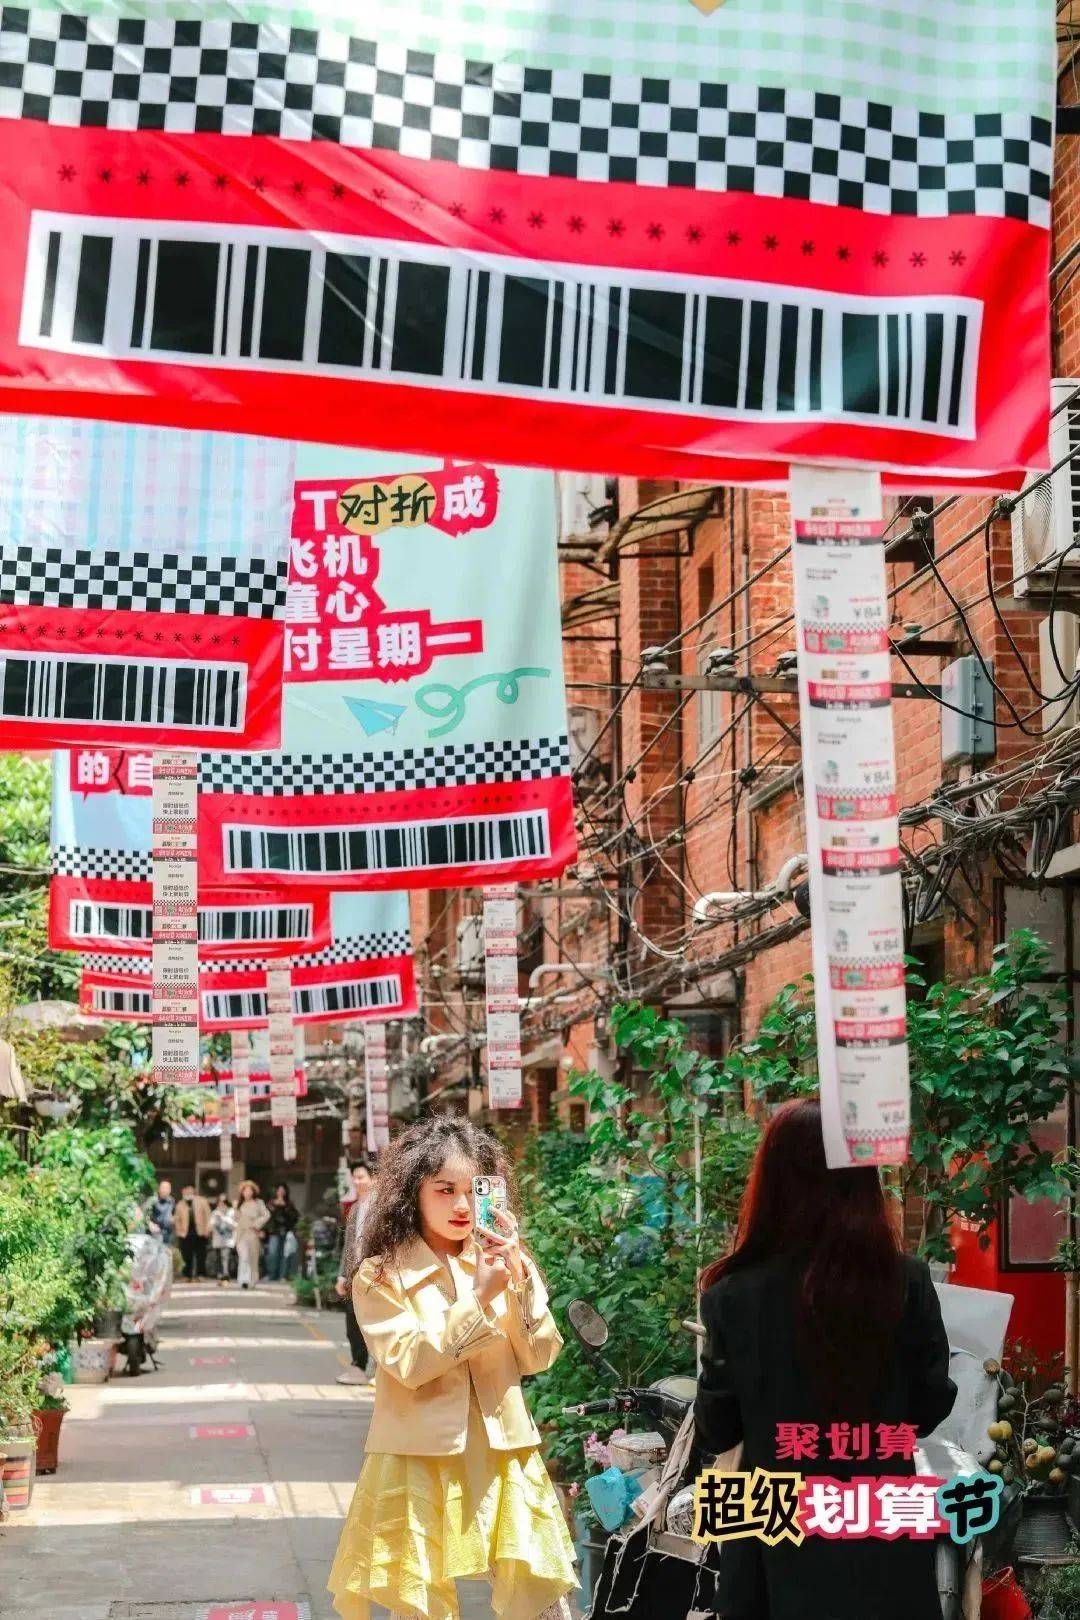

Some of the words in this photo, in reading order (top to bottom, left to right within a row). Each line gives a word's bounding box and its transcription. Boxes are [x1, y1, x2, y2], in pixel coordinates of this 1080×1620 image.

[291, 534, 368, 578] 飞机
[287, 580, 371, 624] 童心
[77, 750, 110, 785] 的
